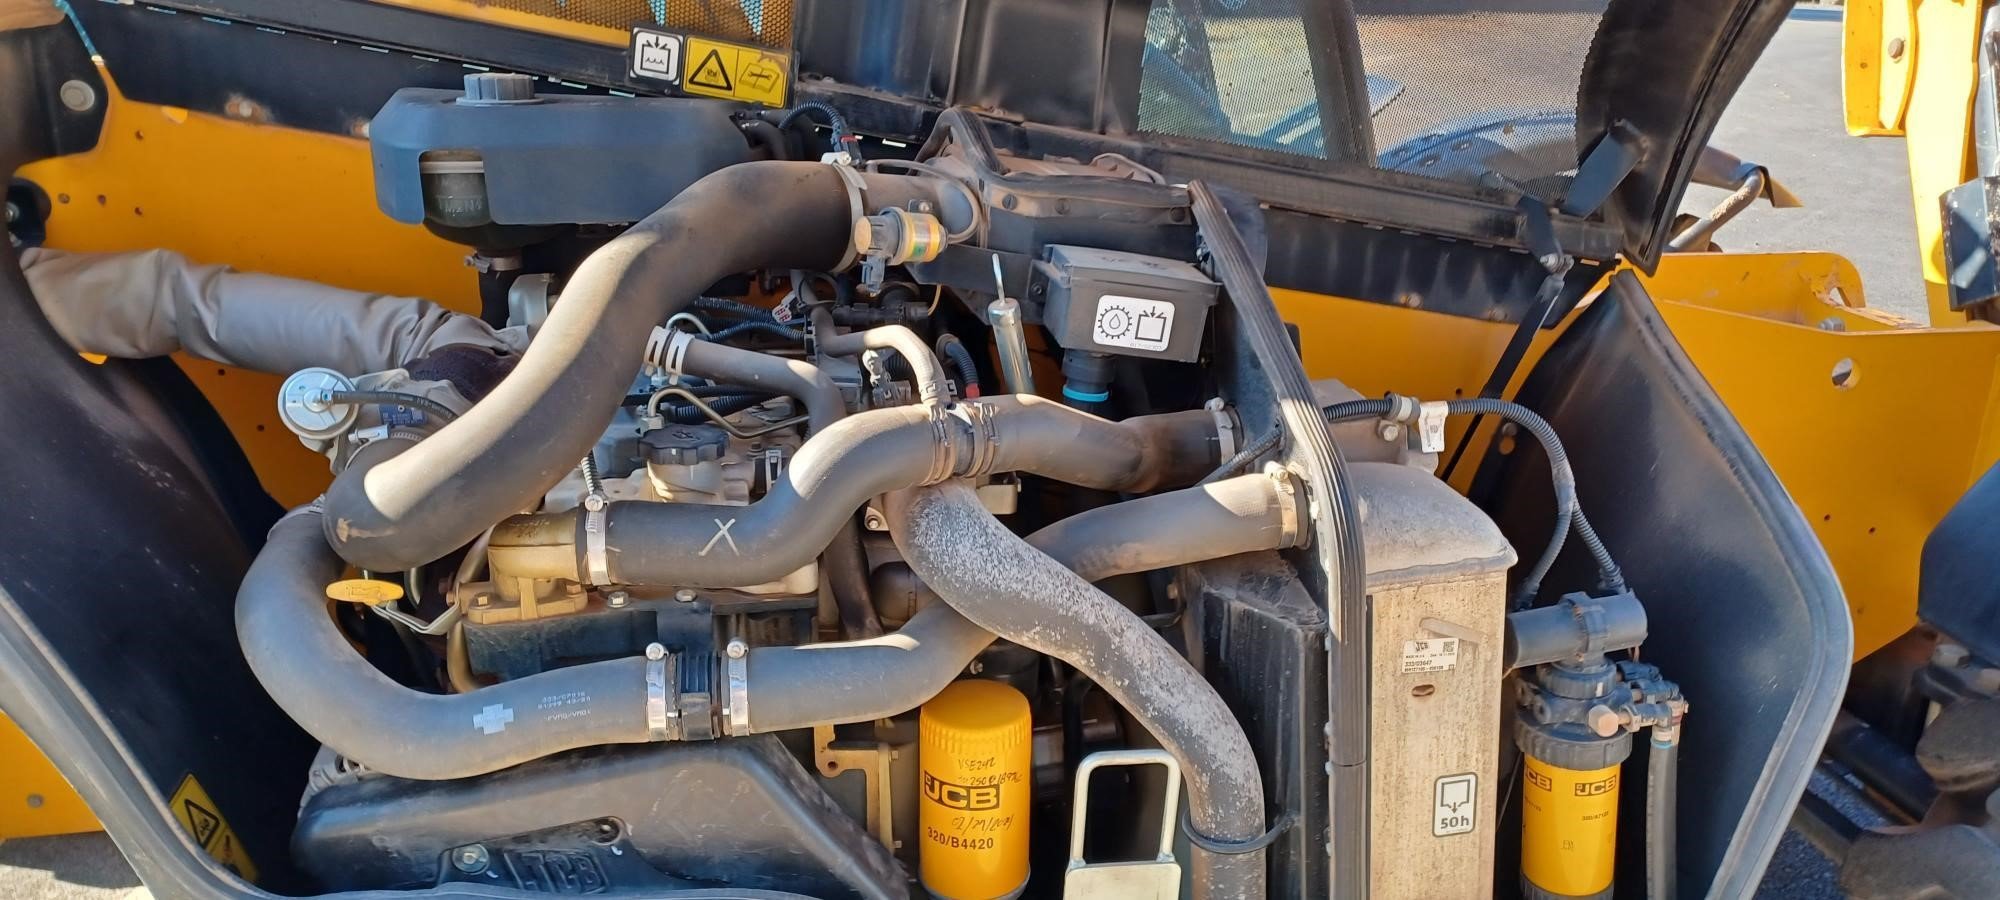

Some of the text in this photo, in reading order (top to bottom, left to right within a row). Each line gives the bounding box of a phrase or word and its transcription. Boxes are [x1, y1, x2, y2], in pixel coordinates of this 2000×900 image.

[1527, 766, 1552, 791] CB
[1575, 775, 1616, 796] JCB
[925, 774, 998, 809] JCB
[927, 826, 994, 849] 320/B4420
